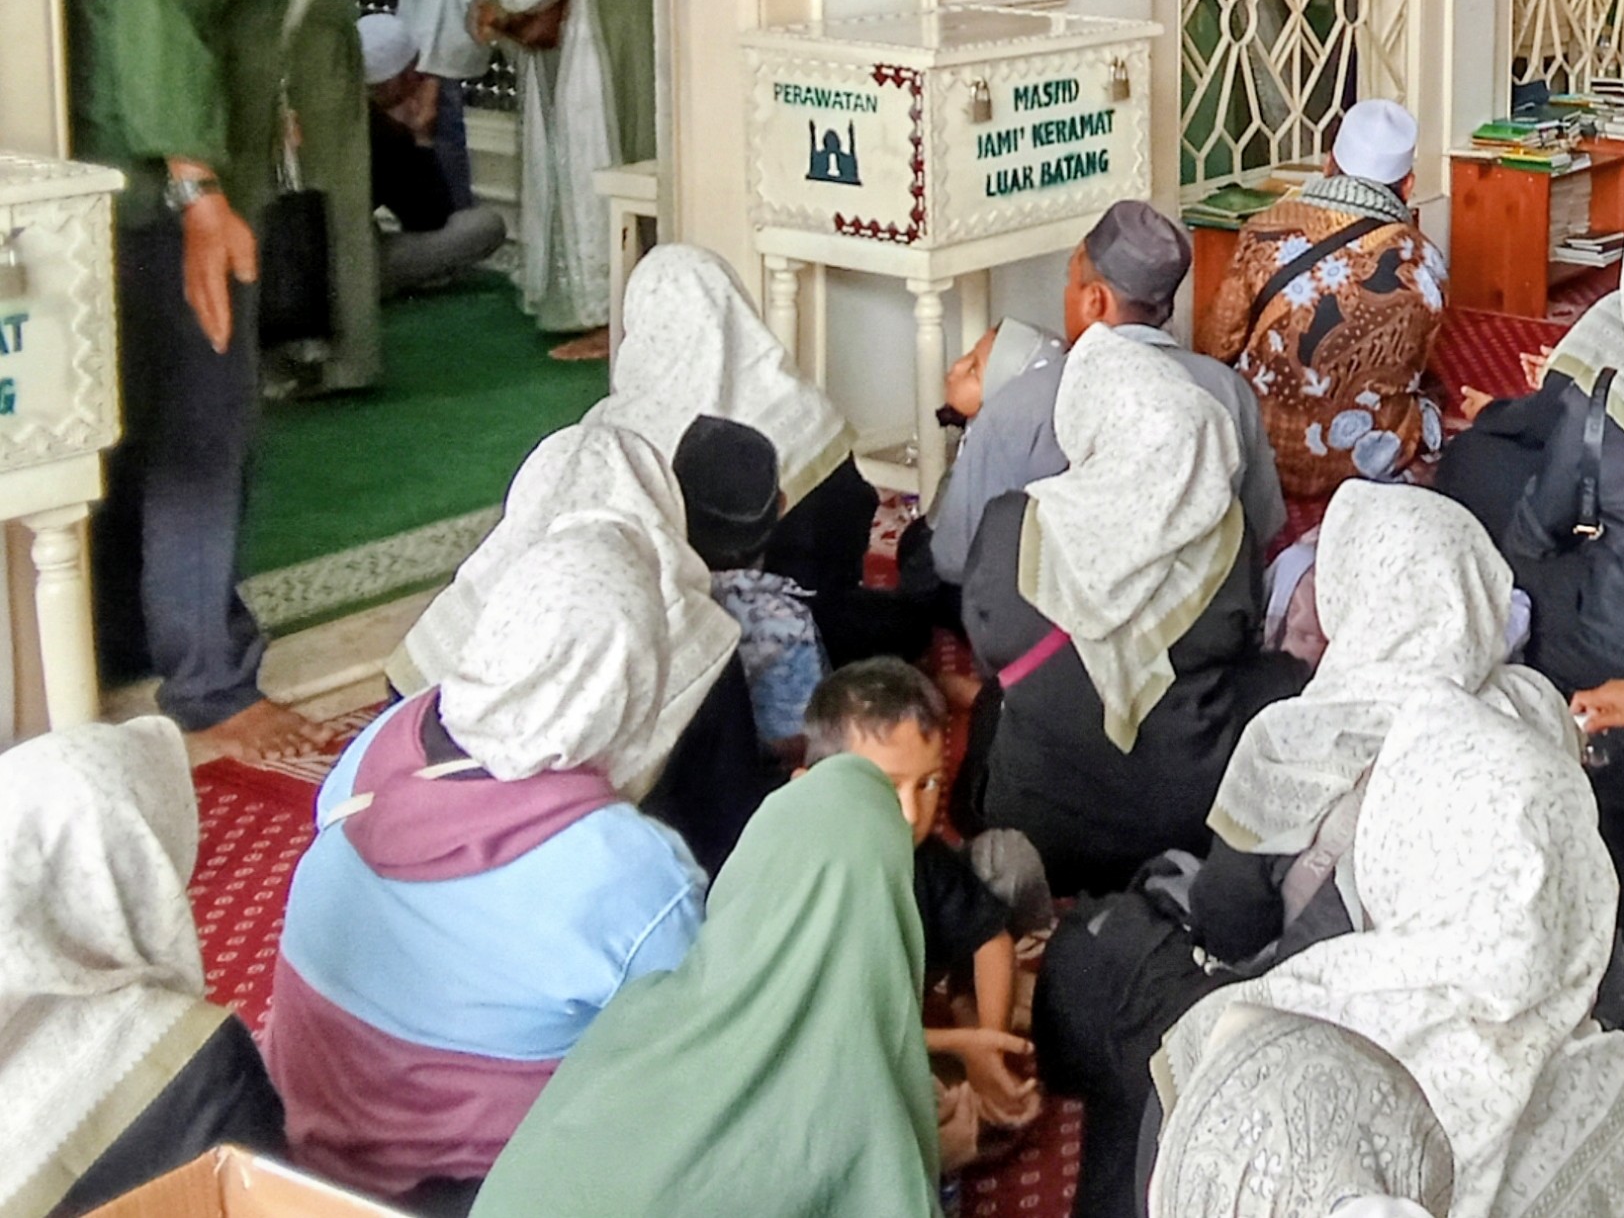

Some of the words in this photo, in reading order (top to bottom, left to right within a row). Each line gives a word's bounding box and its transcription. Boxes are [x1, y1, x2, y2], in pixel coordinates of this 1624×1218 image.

[773, 82, 878, 113] PERAWATAN
[1013, 78, 1080, 112] MASJID
[977, 126, 1025, 160] JAMI'
[1031, 109, 1116, 148] KERAMAT
[986, 165, 1035, 197] LUAR
[1040, 148, 1110, 187] BATANG
